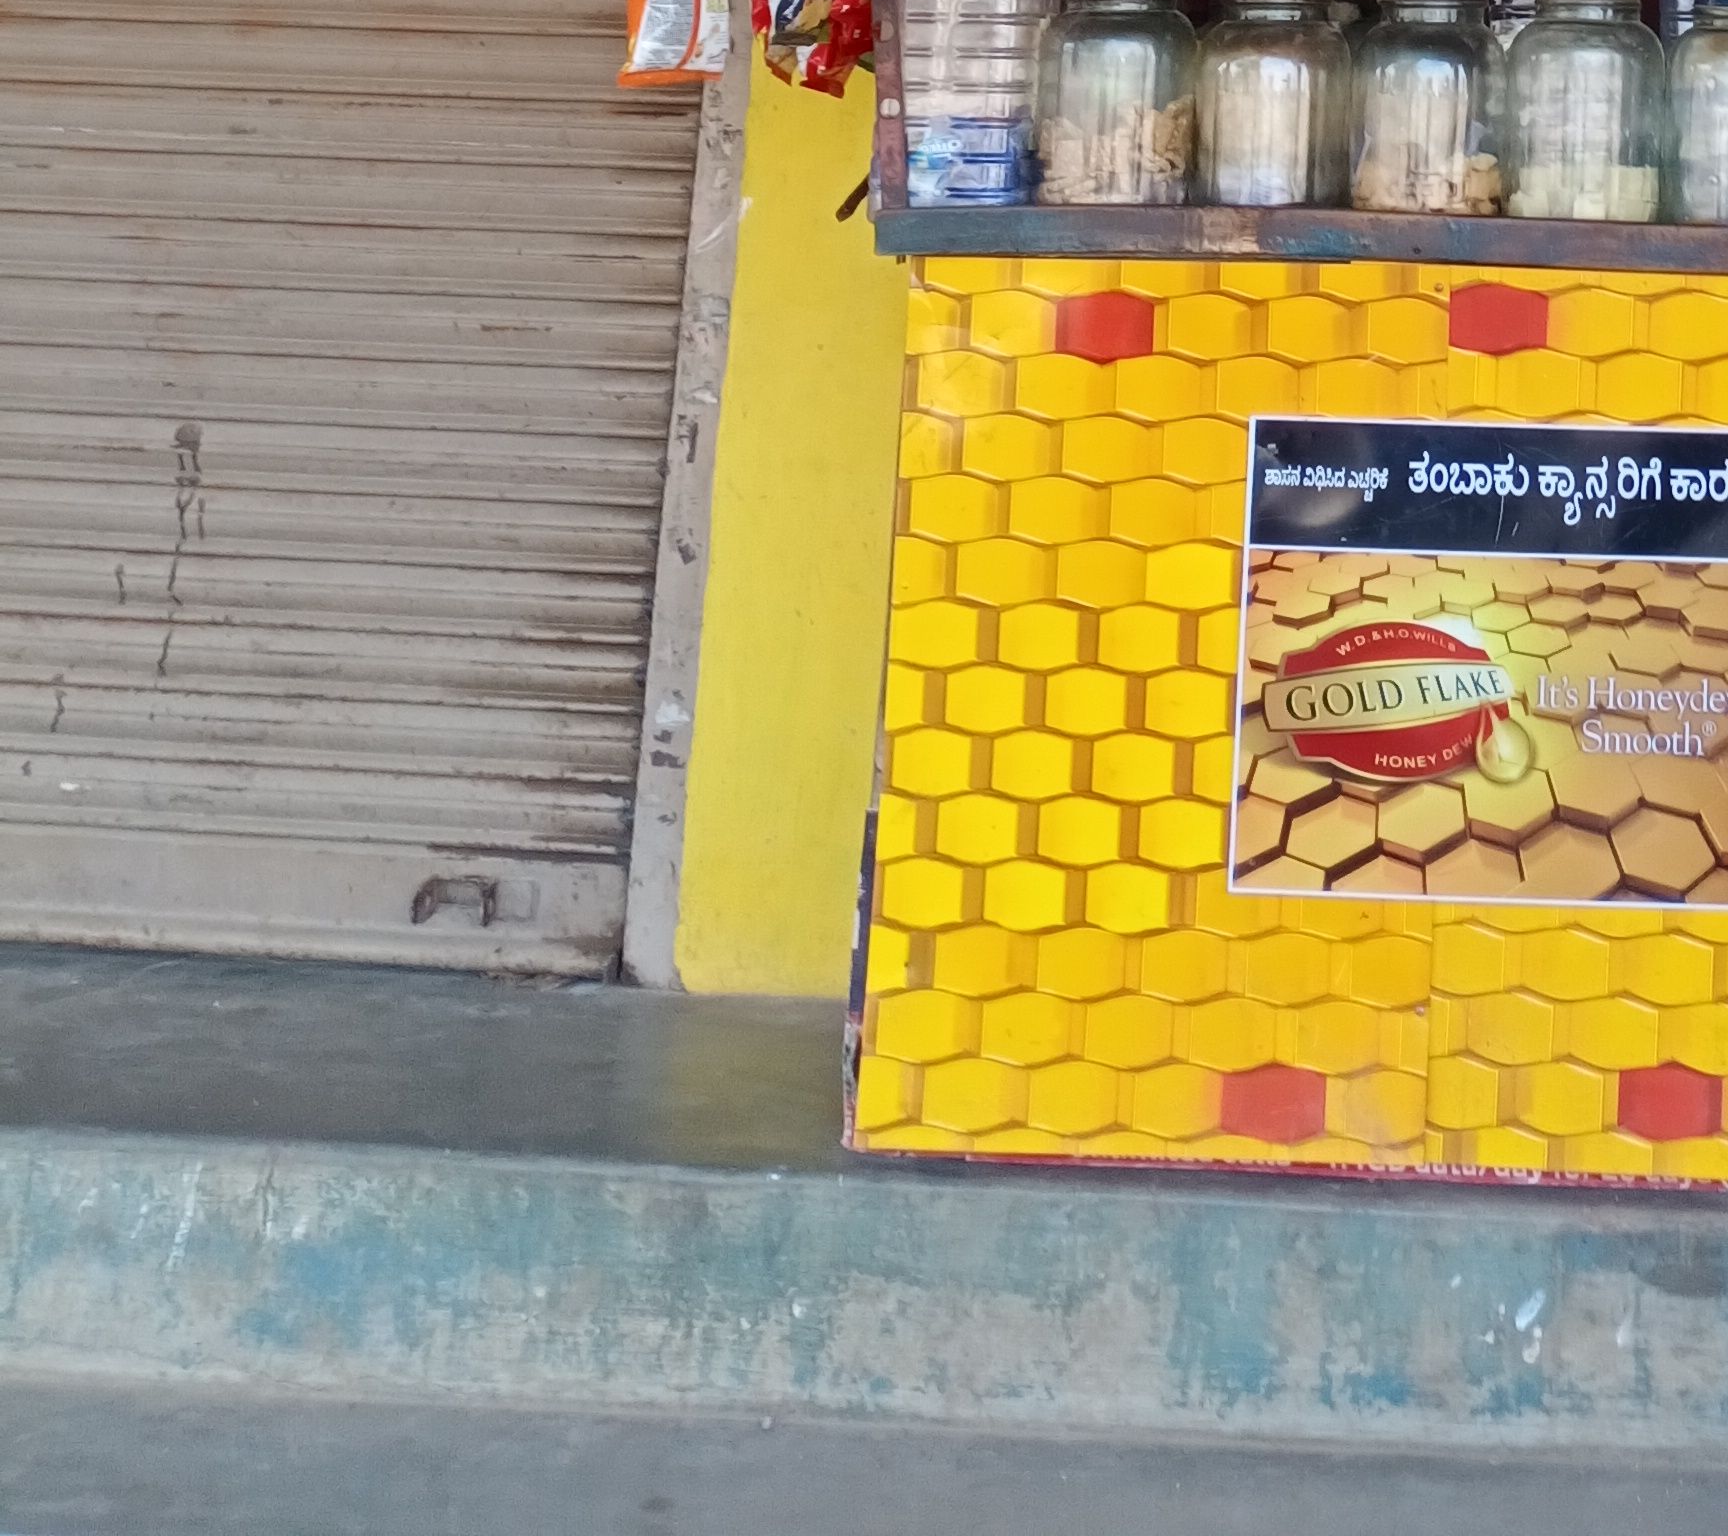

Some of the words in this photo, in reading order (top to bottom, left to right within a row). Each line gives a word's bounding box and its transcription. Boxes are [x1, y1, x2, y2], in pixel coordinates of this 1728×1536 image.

[1264, 467, 1302, 487] ಶಾಸನ
[1407, 450, 1530, 497] ತಂಬಾಕು
[1538, 456, 1662, 526] ಕ್ಯಾನ್ಸರಿಗೆ
[1285, 679, 1404, 722] GOLD
[1419, 669, 1506, 706] FLAKE
[1374, 752, 1437, 770] HONEY
[1443, 734, 1474, 762] DEW
